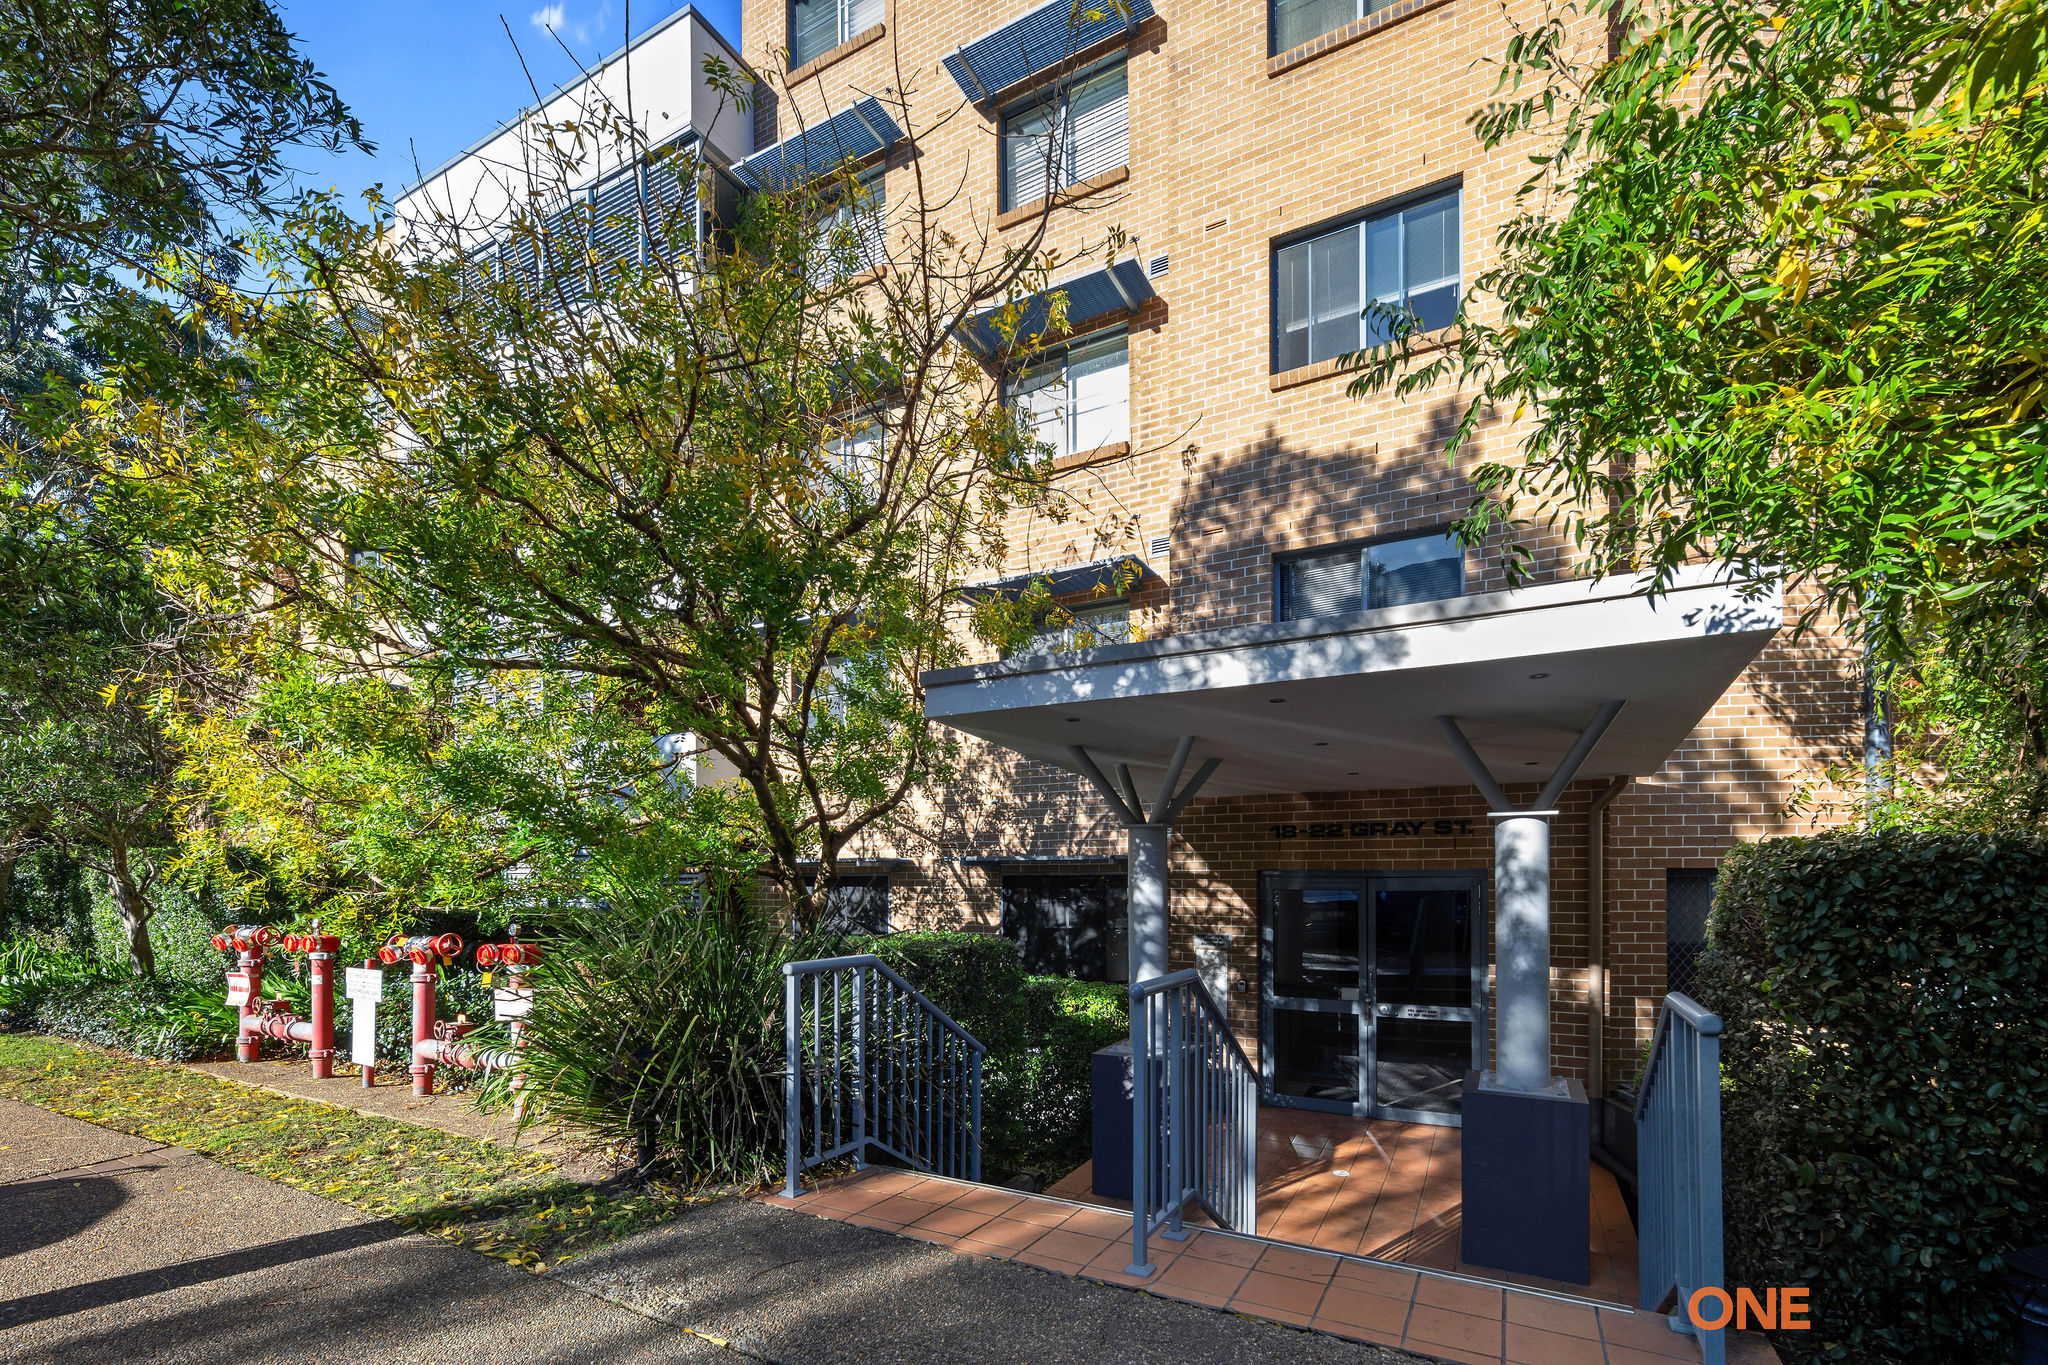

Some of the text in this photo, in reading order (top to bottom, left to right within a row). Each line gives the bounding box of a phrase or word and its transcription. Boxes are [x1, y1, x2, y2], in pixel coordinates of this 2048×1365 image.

[1268, 819, 1474, 839] 18-22 GRAY ST.
